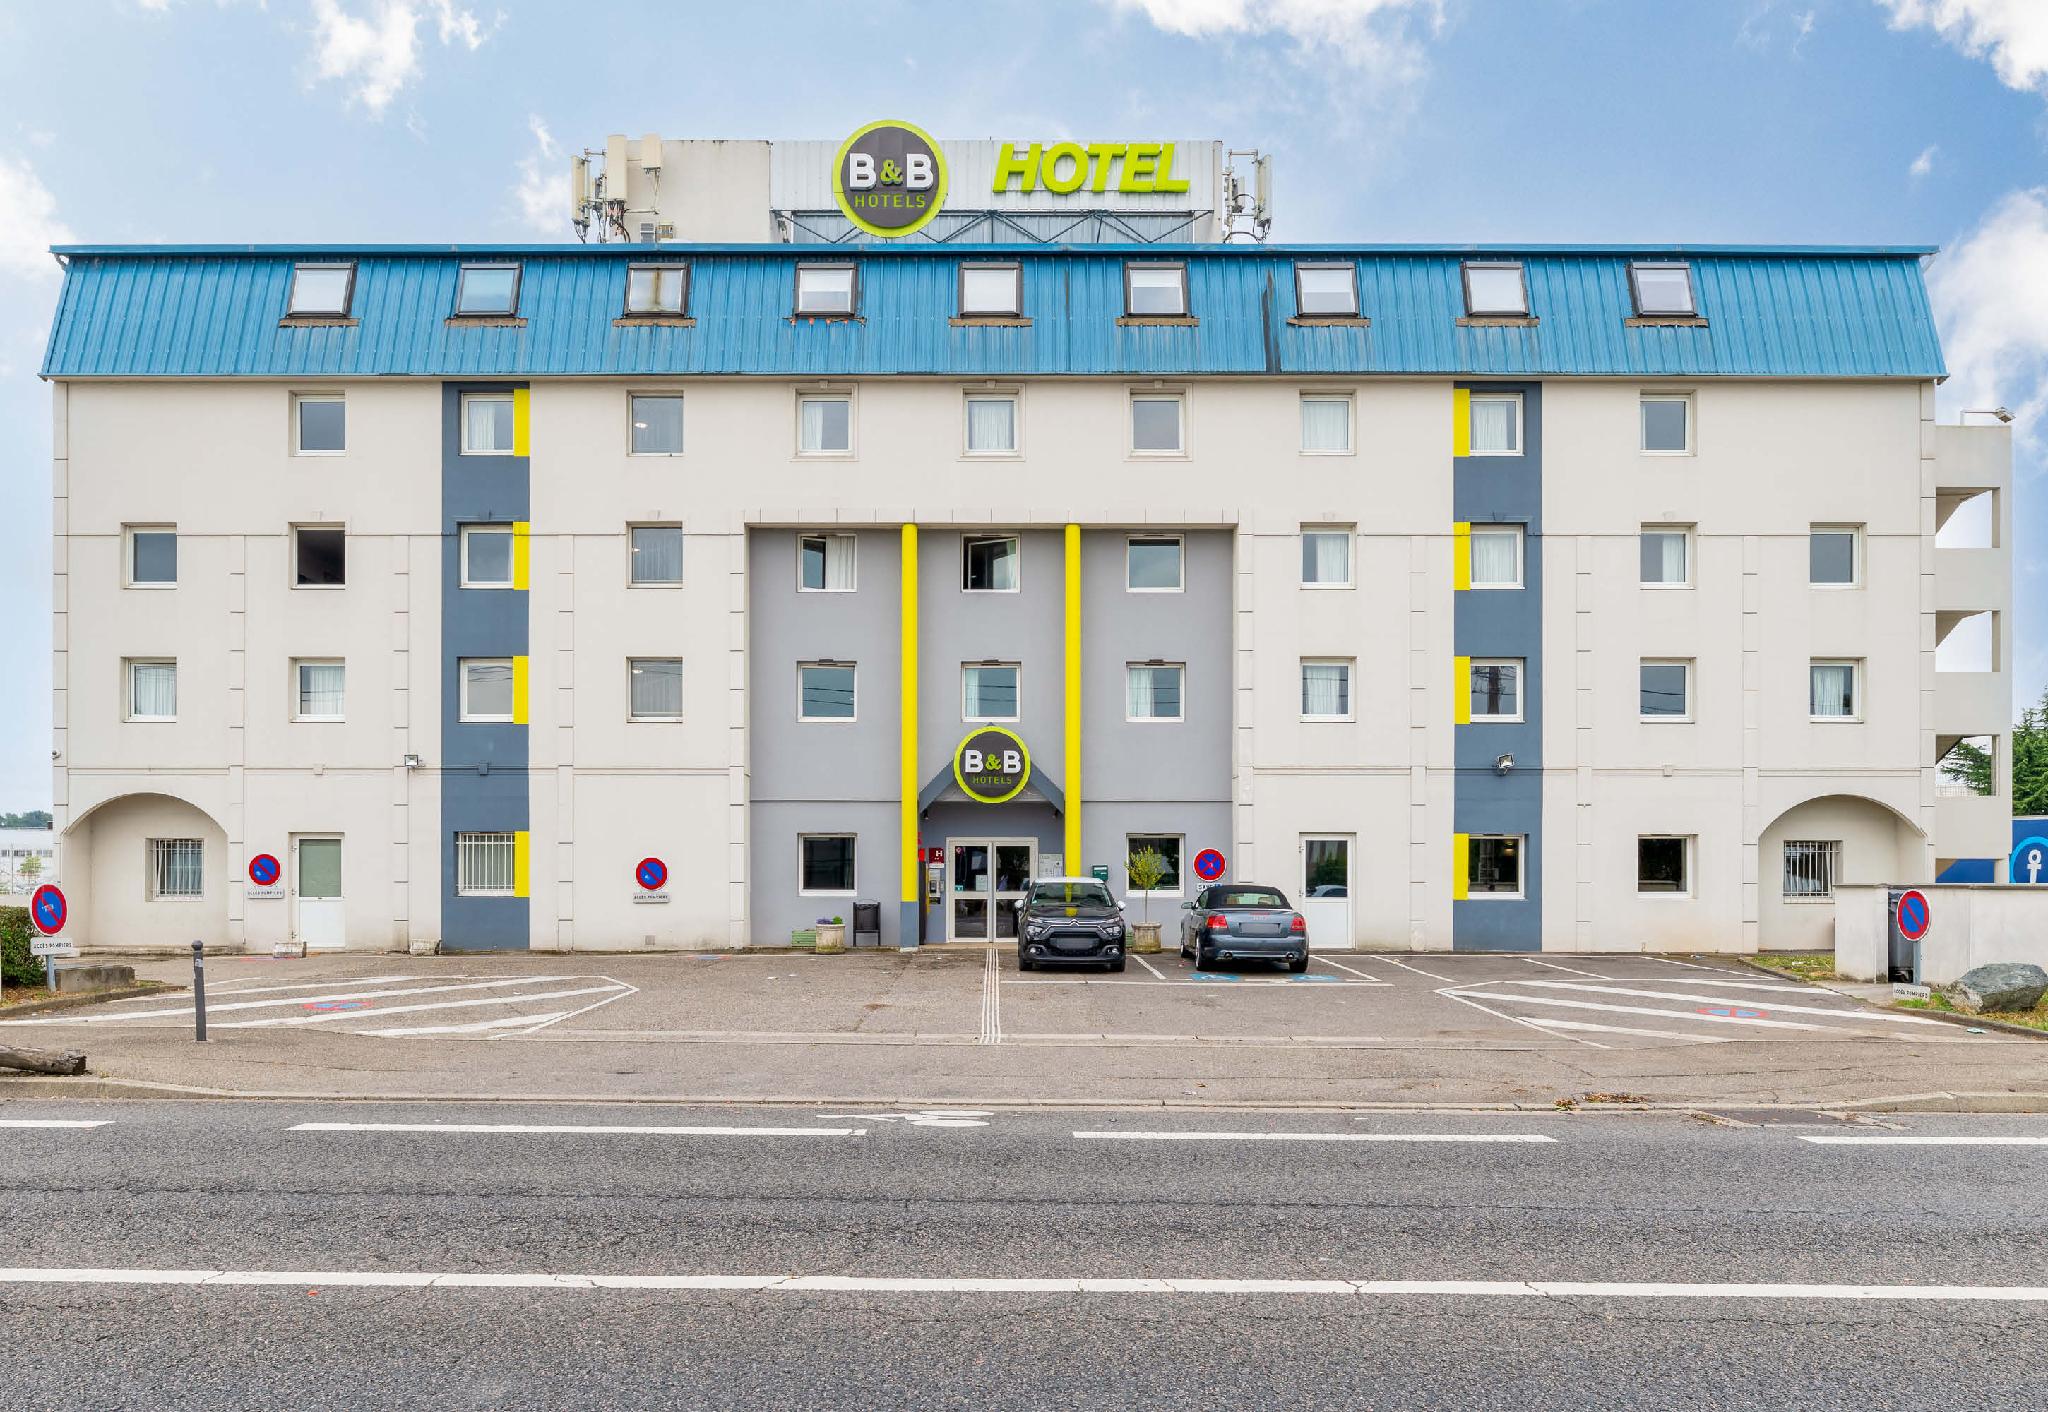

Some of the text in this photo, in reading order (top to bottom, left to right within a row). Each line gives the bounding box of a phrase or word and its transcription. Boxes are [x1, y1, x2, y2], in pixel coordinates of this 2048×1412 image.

[849, 153, 934, 191] B&B
[992, 142, 1191, 194] HOTEL
[854, 194, 926, 209] HOTELS
[965, 749, 1022, 774] B&B
[972, 776, 1012, 785] HOTELS
